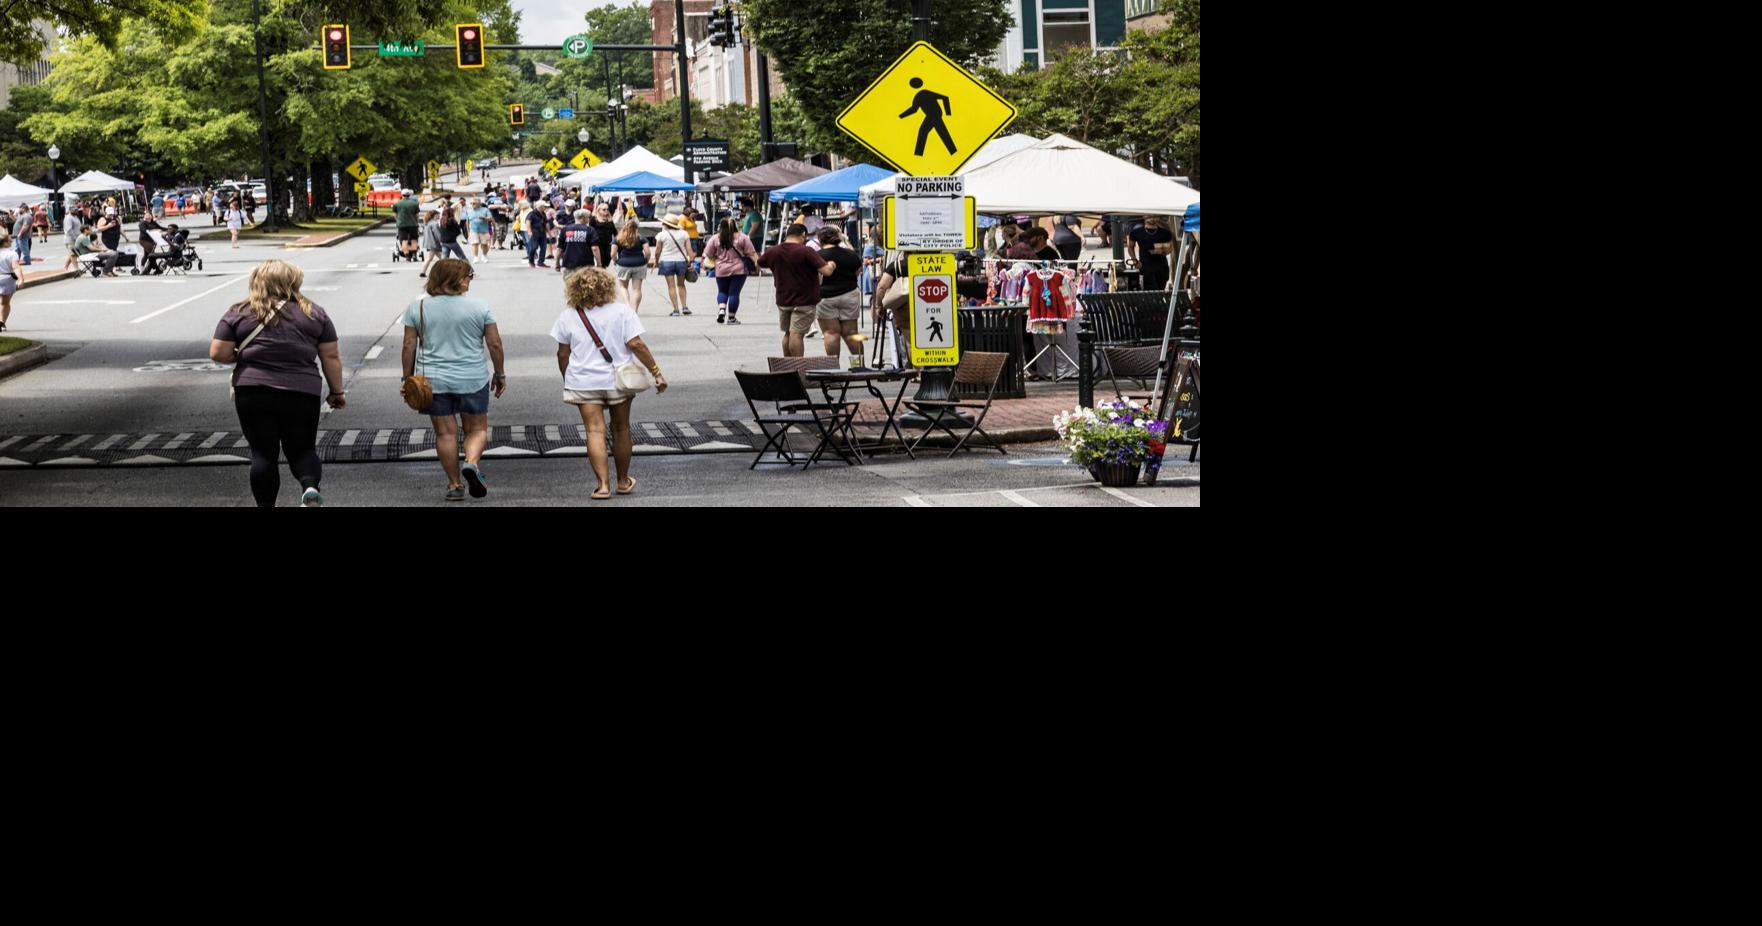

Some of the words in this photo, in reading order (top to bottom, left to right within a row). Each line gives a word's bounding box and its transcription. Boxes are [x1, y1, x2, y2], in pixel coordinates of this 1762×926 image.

[897, 183, 913, 192] NO
[916, 182, 962, 192] PARKING
[916, 256, 947, 264] STATE
[921, 265, 942, 273] LAW
[919, 285, 948, 296] STOP
